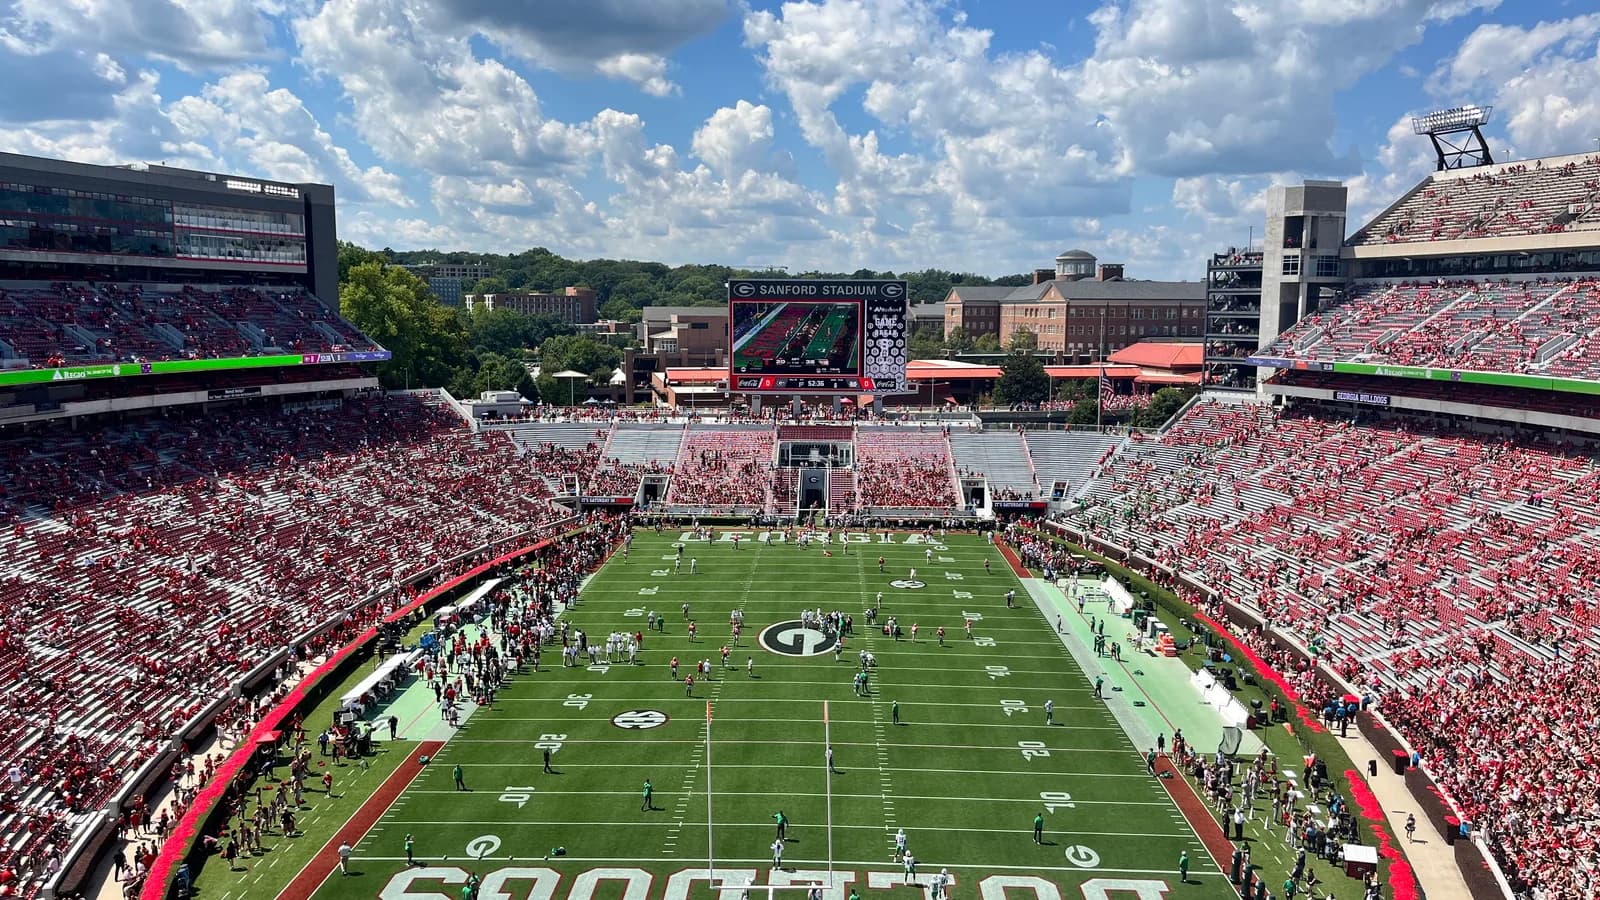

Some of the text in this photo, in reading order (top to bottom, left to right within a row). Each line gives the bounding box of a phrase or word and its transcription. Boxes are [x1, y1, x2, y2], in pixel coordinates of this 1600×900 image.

[759, 285, 877, 295] SANFORD STADIUM
[1336, 392, 1388, 404] GEORGIA BULLDOGS
[761, 620, 841, 656] G
[563, 694, 593, 706] 30
[1000, 700, 1029, 712] 30
[534, 734, 567, 749] 20
[1018, 741, 1050, 757] 20
[498, 786, 535, 802] 10
[1040, 791, 1076, 808] 10
